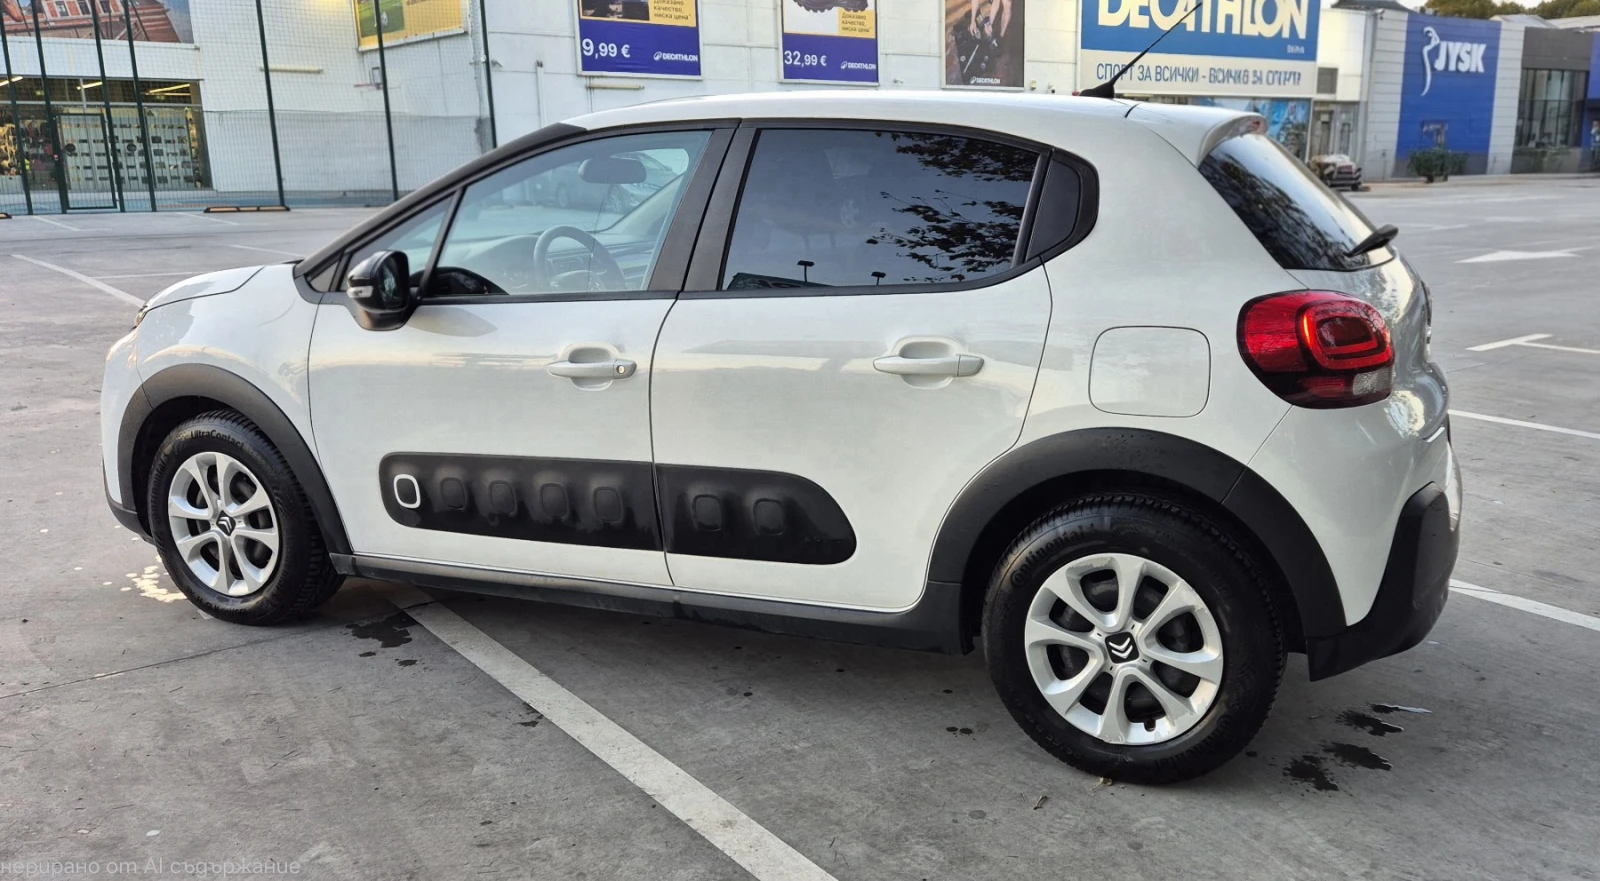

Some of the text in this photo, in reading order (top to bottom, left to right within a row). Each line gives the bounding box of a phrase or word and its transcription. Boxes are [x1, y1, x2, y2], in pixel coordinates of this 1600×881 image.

[582, 38, 631, 59] 9,99 €
[662, 52, 698, 62] DECATHLON
[1434, 41, 1487, 73] JYSK
[784, 50, 827, 67] 32,99 €
[848, 62, 876, 70] DECATHLON
[1137, 65, 1152, 81] ЗА
[1155, 65, 1199, 83] ВСИЧКИ
[190, 429, 245, 449] UltraContact
